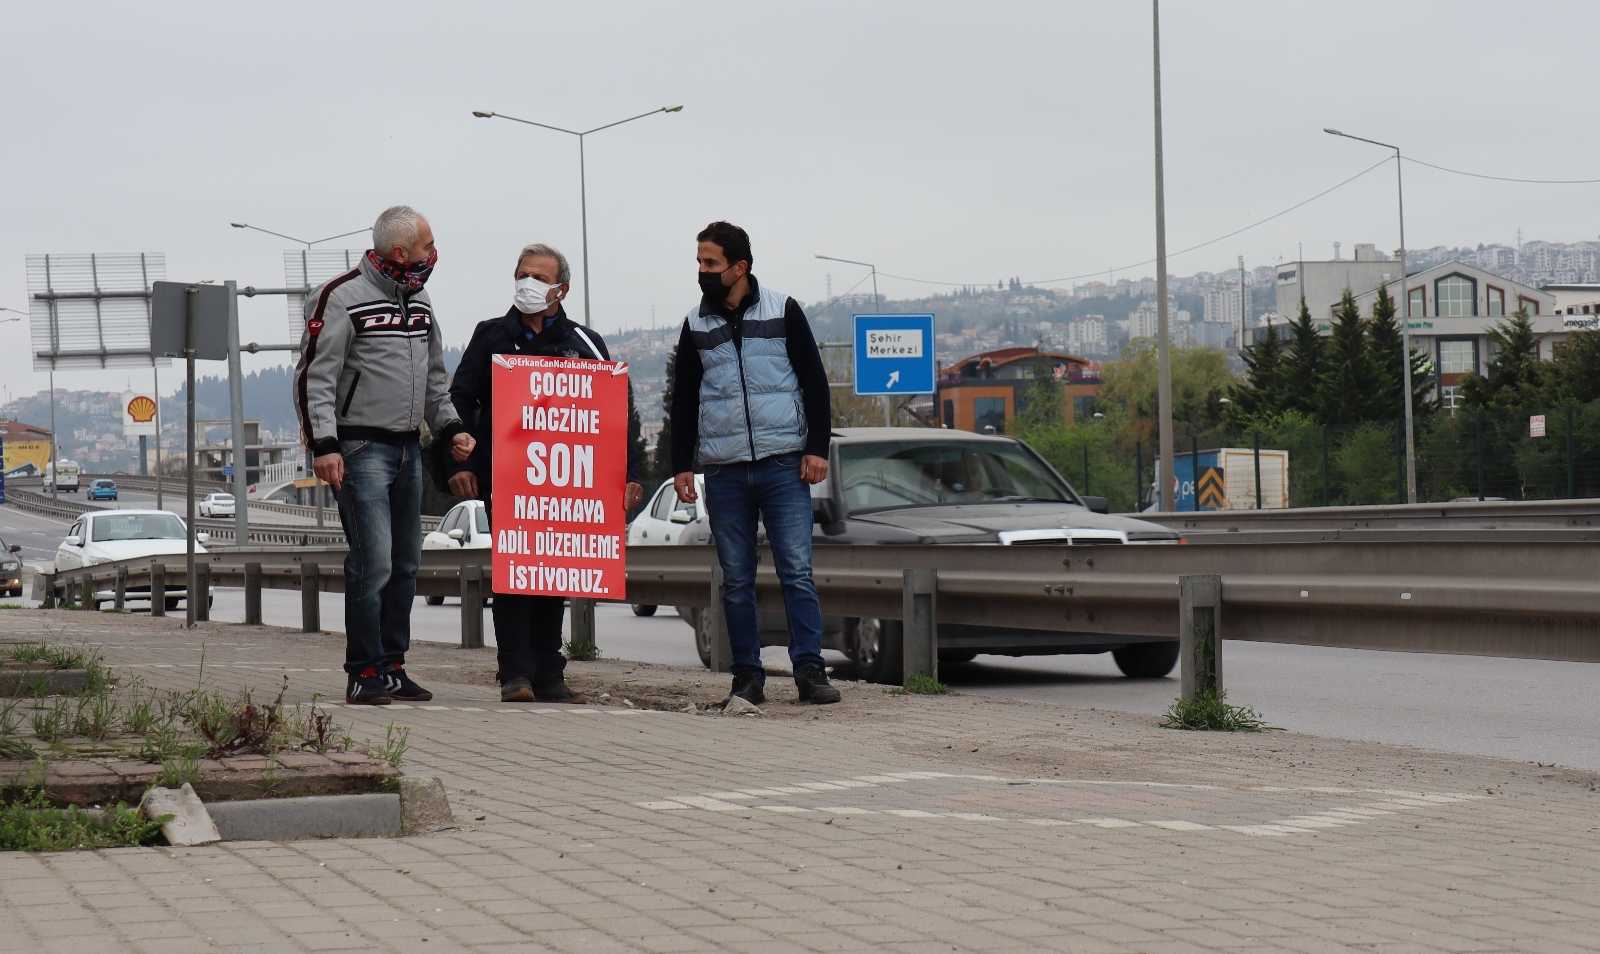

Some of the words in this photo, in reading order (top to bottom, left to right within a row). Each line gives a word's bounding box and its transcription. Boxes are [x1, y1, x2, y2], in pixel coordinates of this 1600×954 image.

[870, 333, 902, 343] Şehir
[870, 344, 917, 355] Merkezi
[507, 357, 614, 372] @ErkanCanNafakaMagduru
[529, 371, 593, 401] ÇOCUK
[522, 404, 600, 435] HACZİNE
[526, 441, 595, 489] SON
[514, 495, 605, 524] NAFAKAYA
[498, 525, 531, 555] ADİL
[535, 527, 620, 560] DÜZENLEME
[509, 559, 609, 594] İSTİYORUZ.
